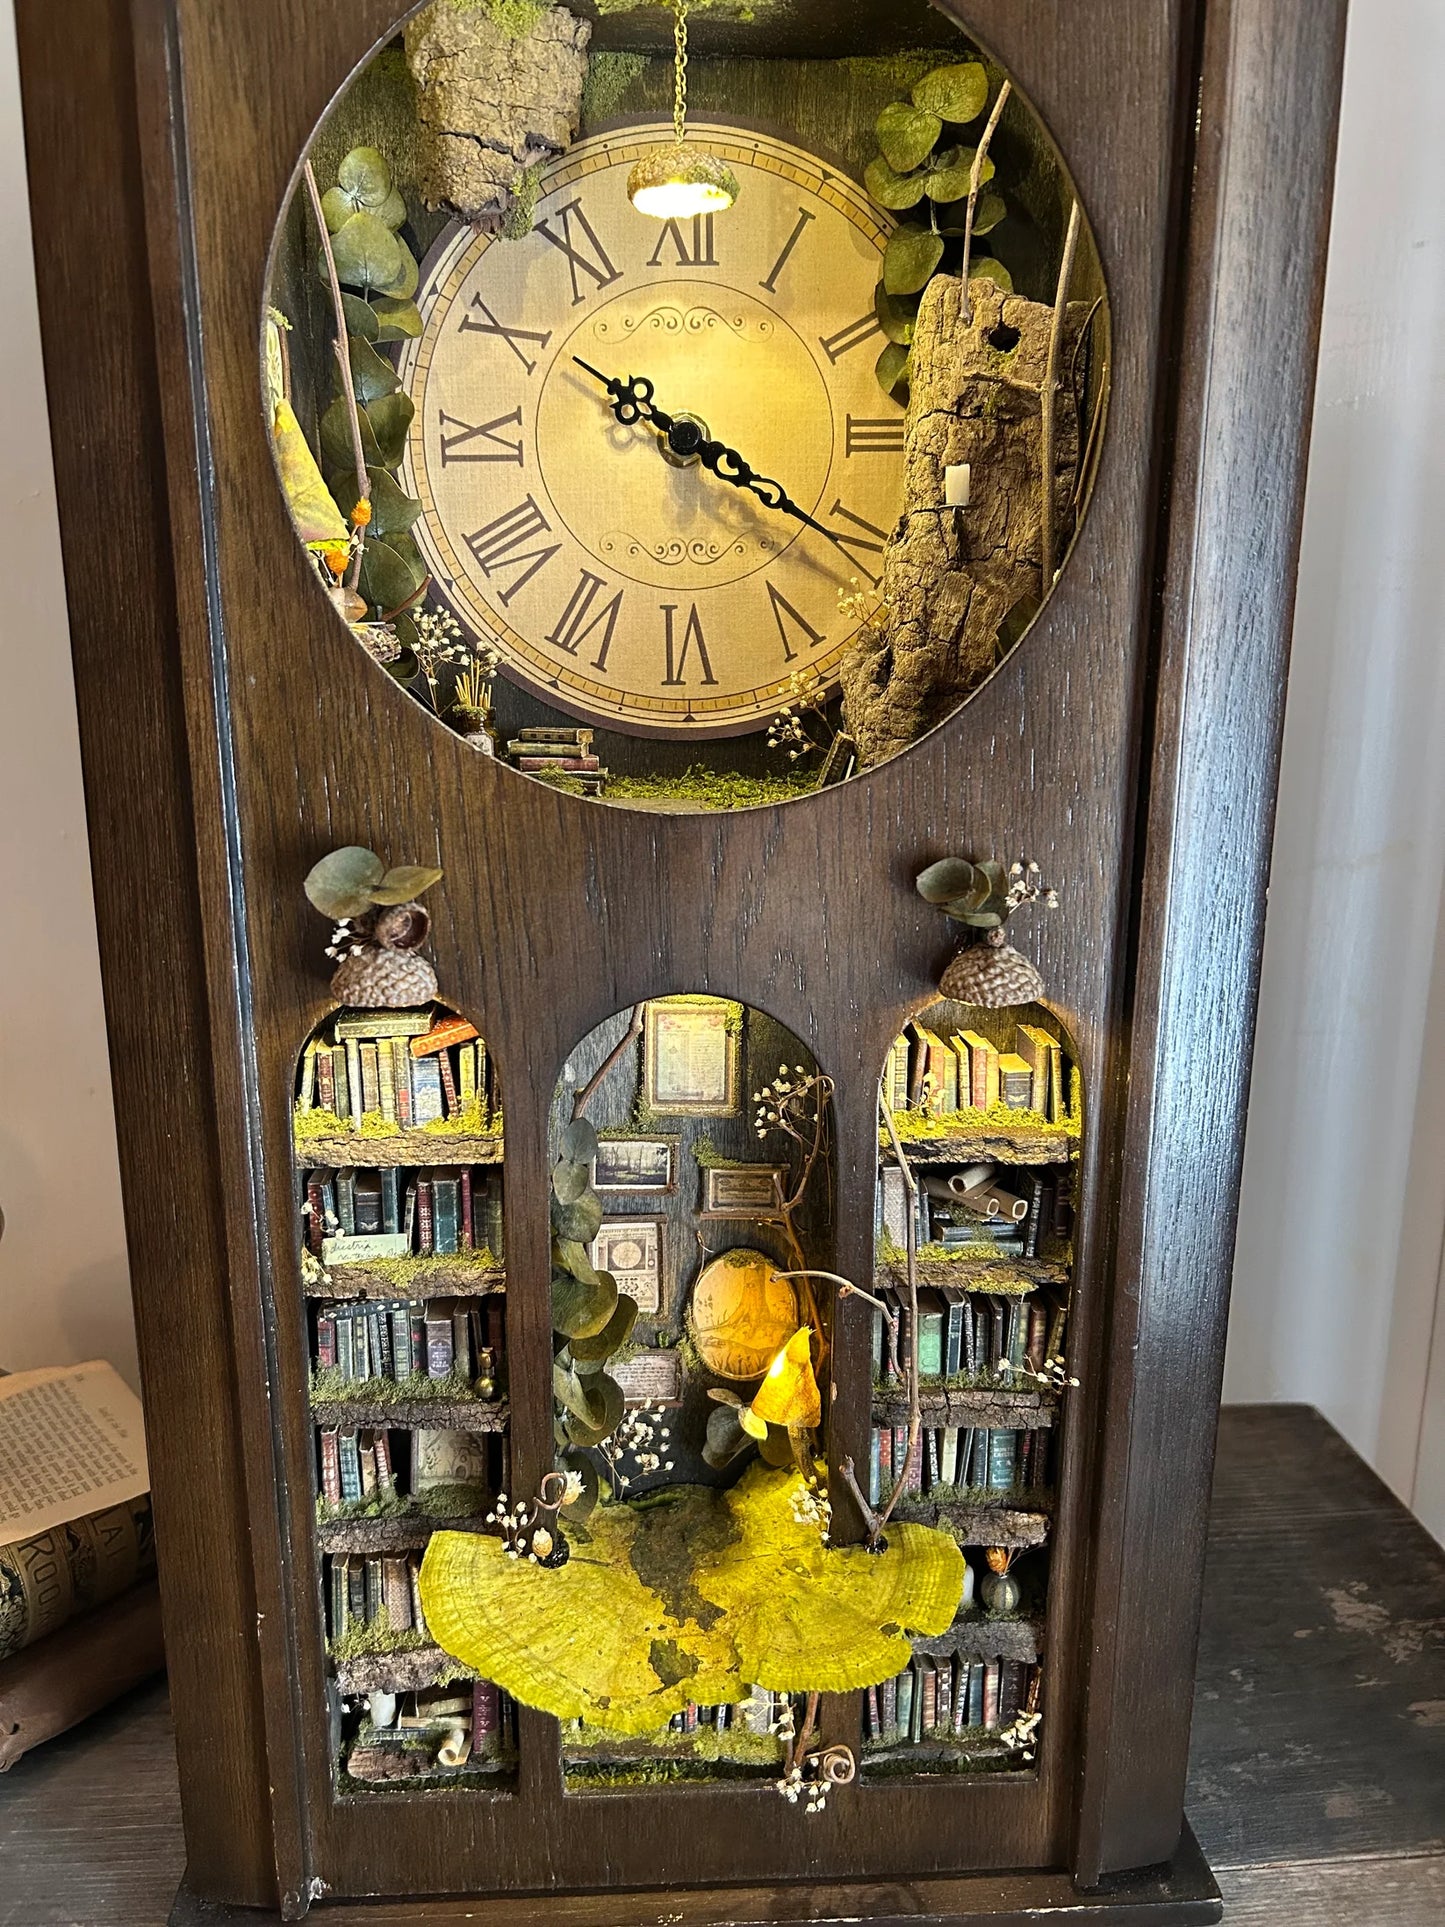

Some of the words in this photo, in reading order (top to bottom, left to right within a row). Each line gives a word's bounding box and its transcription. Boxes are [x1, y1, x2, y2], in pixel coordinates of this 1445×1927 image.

[533, 197, 624, 306] XI
[759, 207, 816, 293] I
[458, 292, 552, 376] X
[819, 311, 883, 366] II
[439, 405, 524, 468] IX
[846, 413, 905, 458] III
[461, 493, 563, 608] VIII
[827, 498, 890, 590] IV
[544, 568, 624, 673] VII
[660, 602, 719, 685] VI
[766, 580, 827, 663] V
